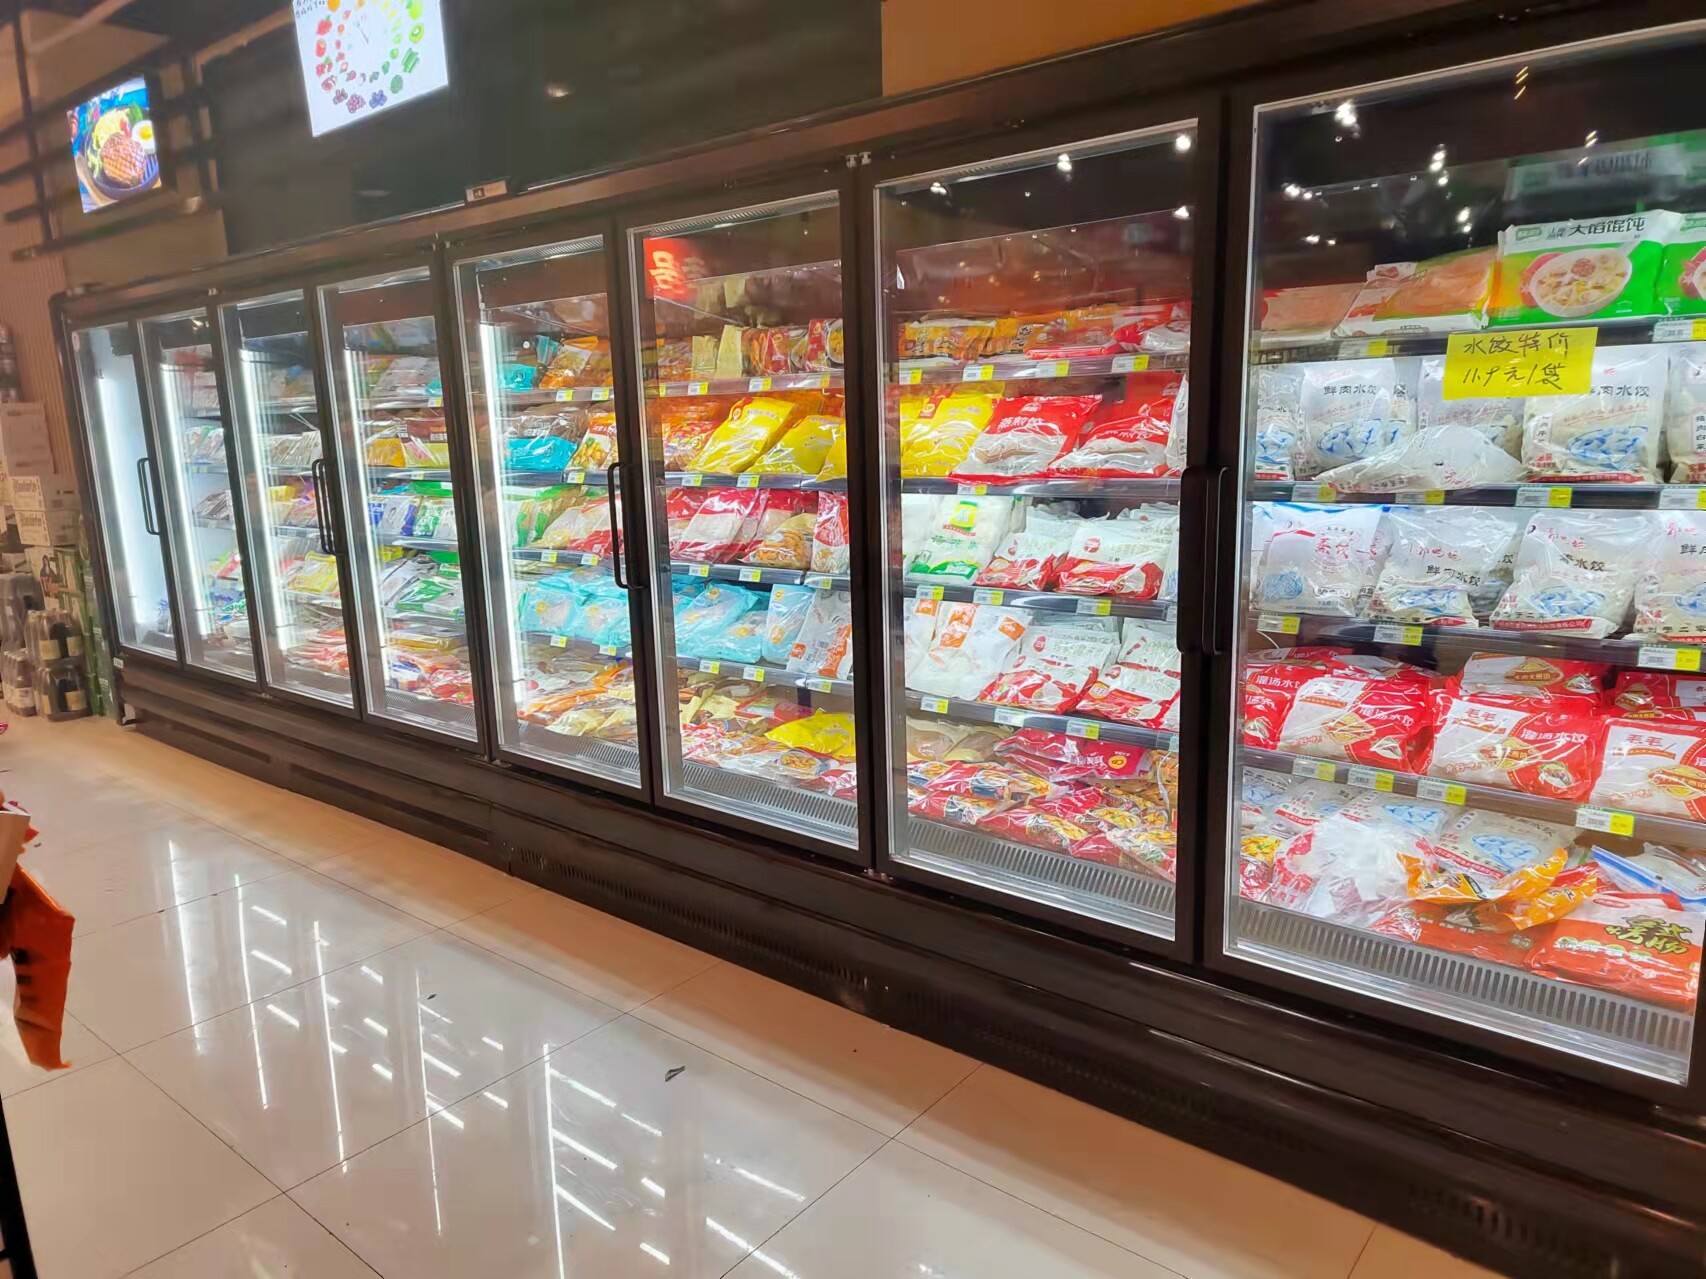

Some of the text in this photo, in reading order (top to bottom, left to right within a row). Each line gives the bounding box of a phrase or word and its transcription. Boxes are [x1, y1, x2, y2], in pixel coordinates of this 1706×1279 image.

[1568, 216, 1646, 237] 大馅馄饨
[1464, 331, 1569, 359] 水饺特价
[1590, 384, 1650, 397] 肉水饺
[1465, 708, 1497, 721] 毛毛
[1520, 728, 1588, 744] 灌汤水饺
[1626, 733, 1664, 746] 毛毛
